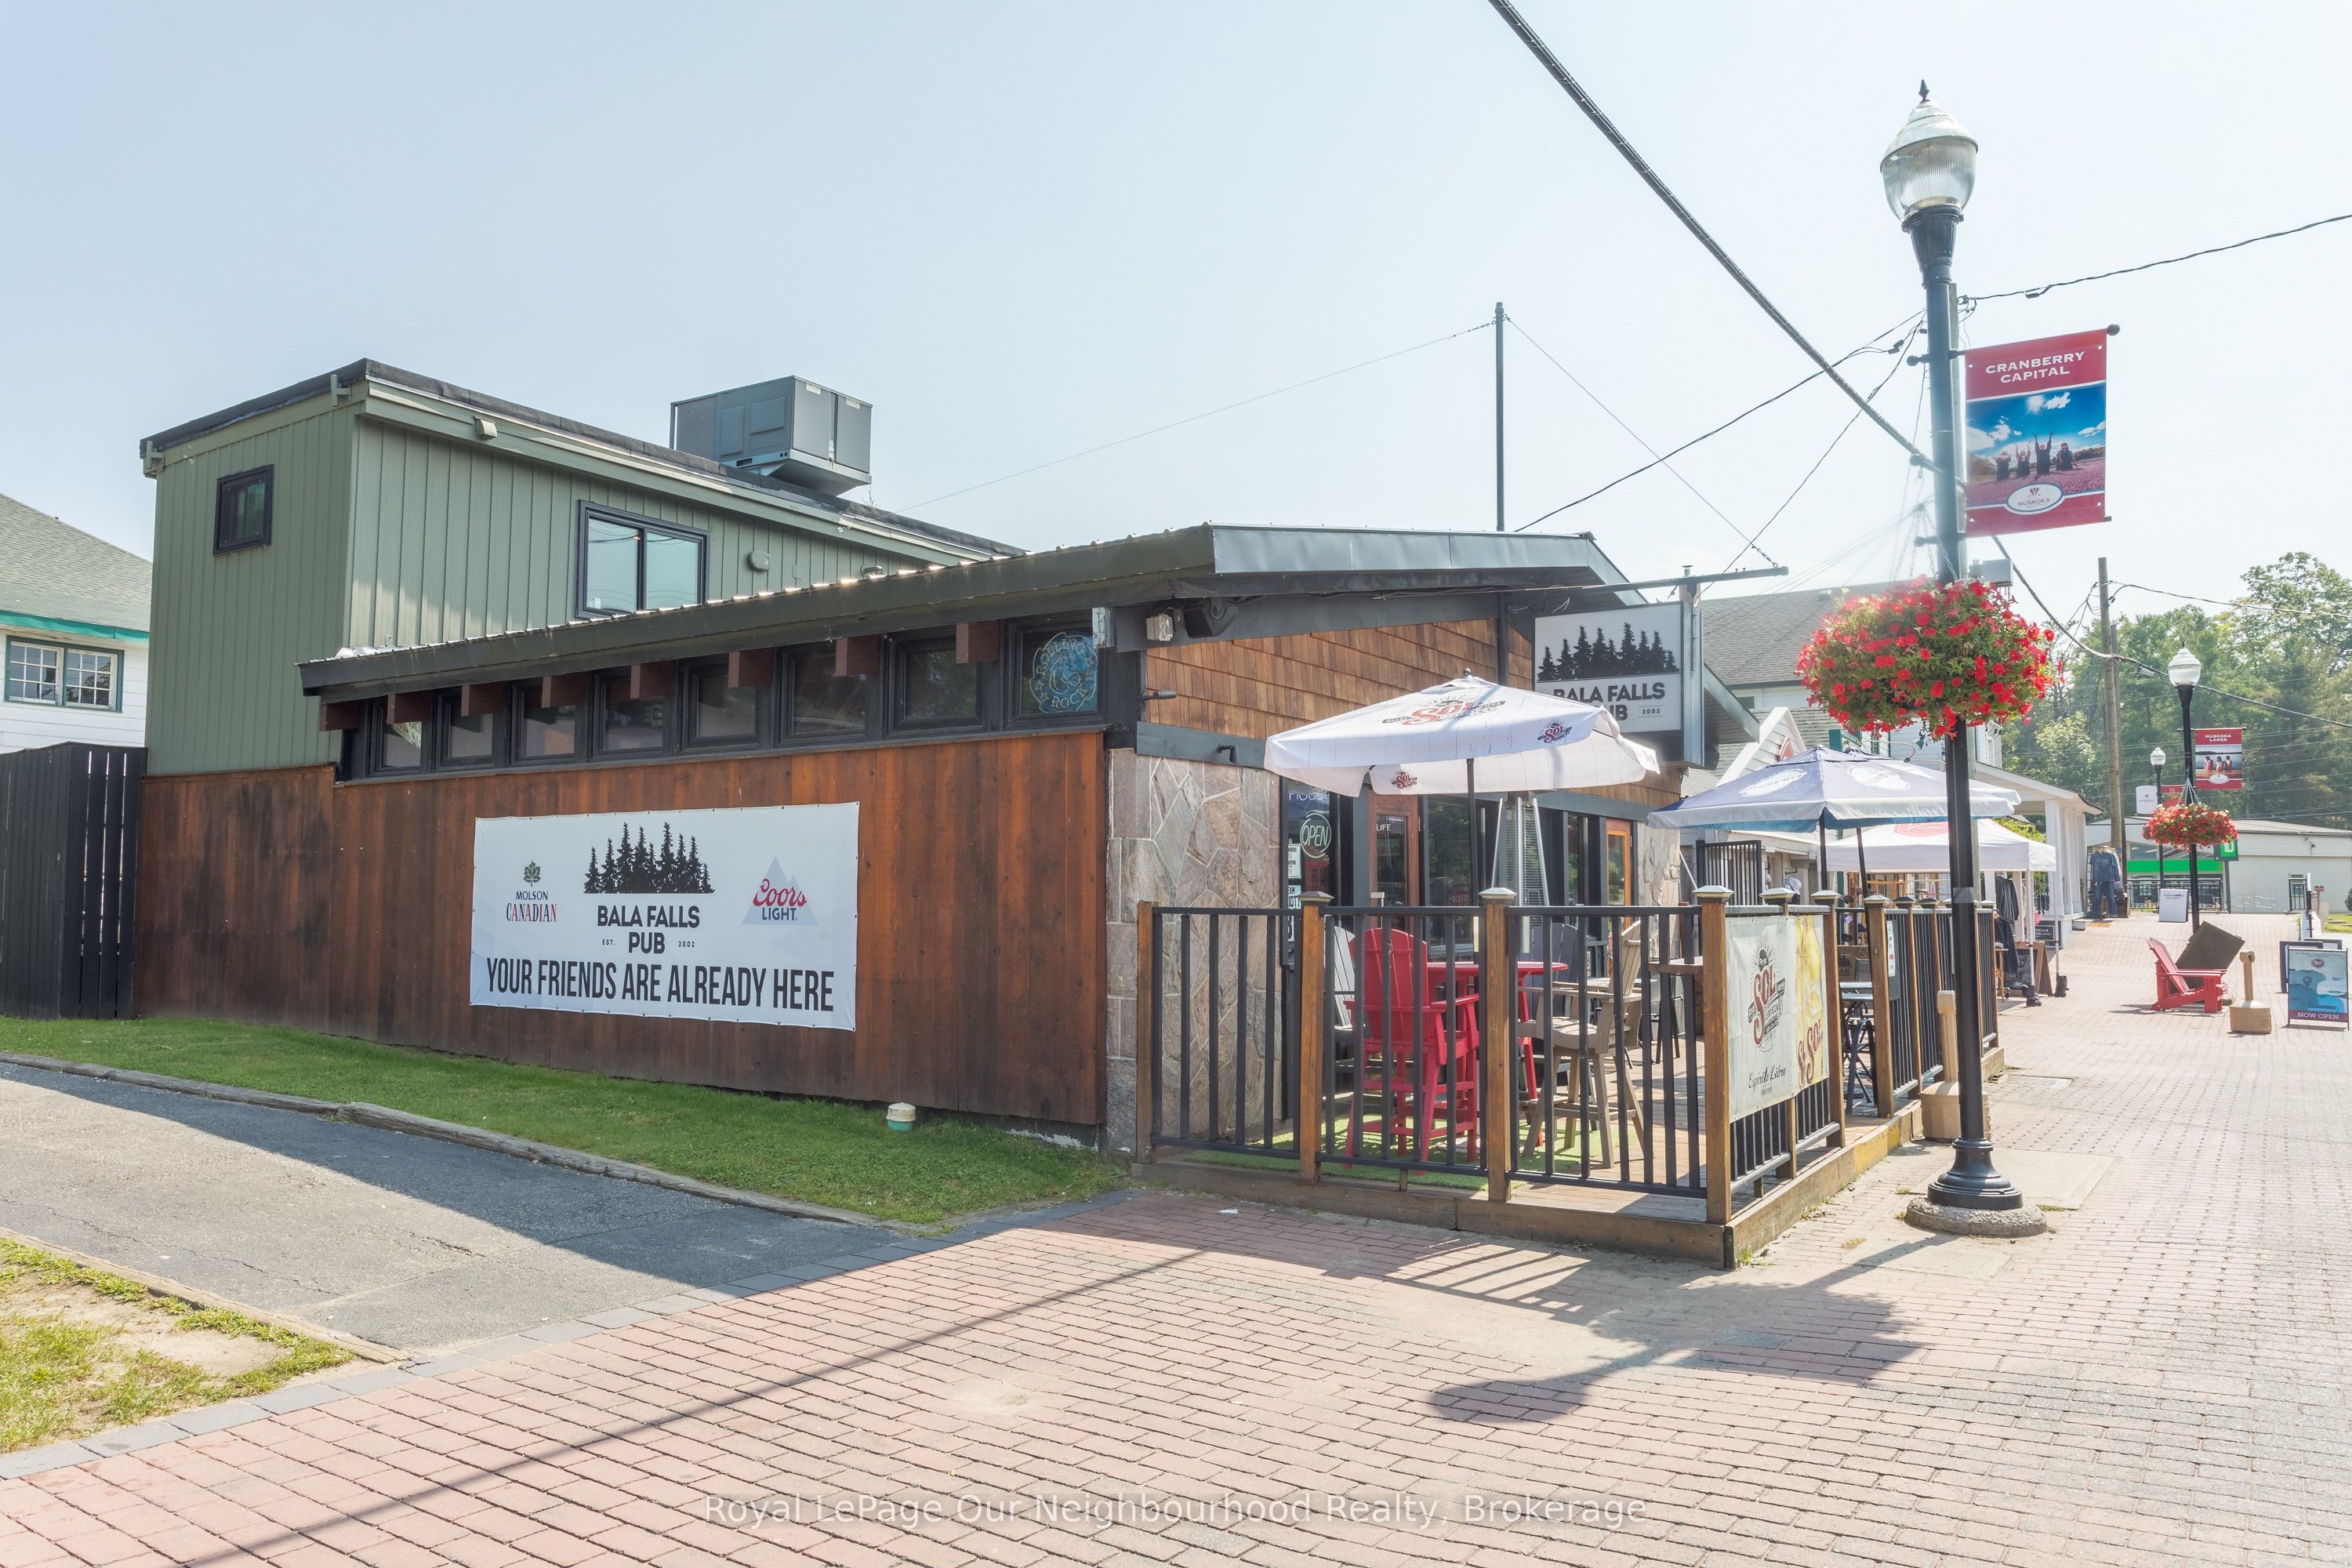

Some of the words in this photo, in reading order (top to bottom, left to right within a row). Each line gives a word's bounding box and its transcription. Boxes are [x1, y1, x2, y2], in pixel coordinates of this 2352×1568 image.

[1986, 351, 2085, 374] CRANBERRY
[2000, 366, 2070, 383] CAPITAL
[2018, 498, 2050, 506] MUSKOKA
[1051, 683, 1088, 709] ROCK
[1553, 686, 1604, 702] BALA
[1608, 682, 1665, 702] FALLS
[1302, 824, 1329, 847] OPEN
[515, 891, 549, 900] MOLSON
[753, 878, 808, 907] Coors
[506, 902, 557, 923] CANADIAN
[597, 905, 643, 927] BALA
[647, 905, 700, 929] FALLS
[762, 907, 797, 921] LIGHT
[628, 931, 666, 954] PUB
[487, 957, 533, 994] YOUR
[537, 960, 617, 1000] FRIENDS
[622, 963, 662, 1002] ARE
[667, 964, 767, 1007] ALREADY
[773, 969, 834, 1012] HERE
[1753, 964, 1776, 1046] SOL
